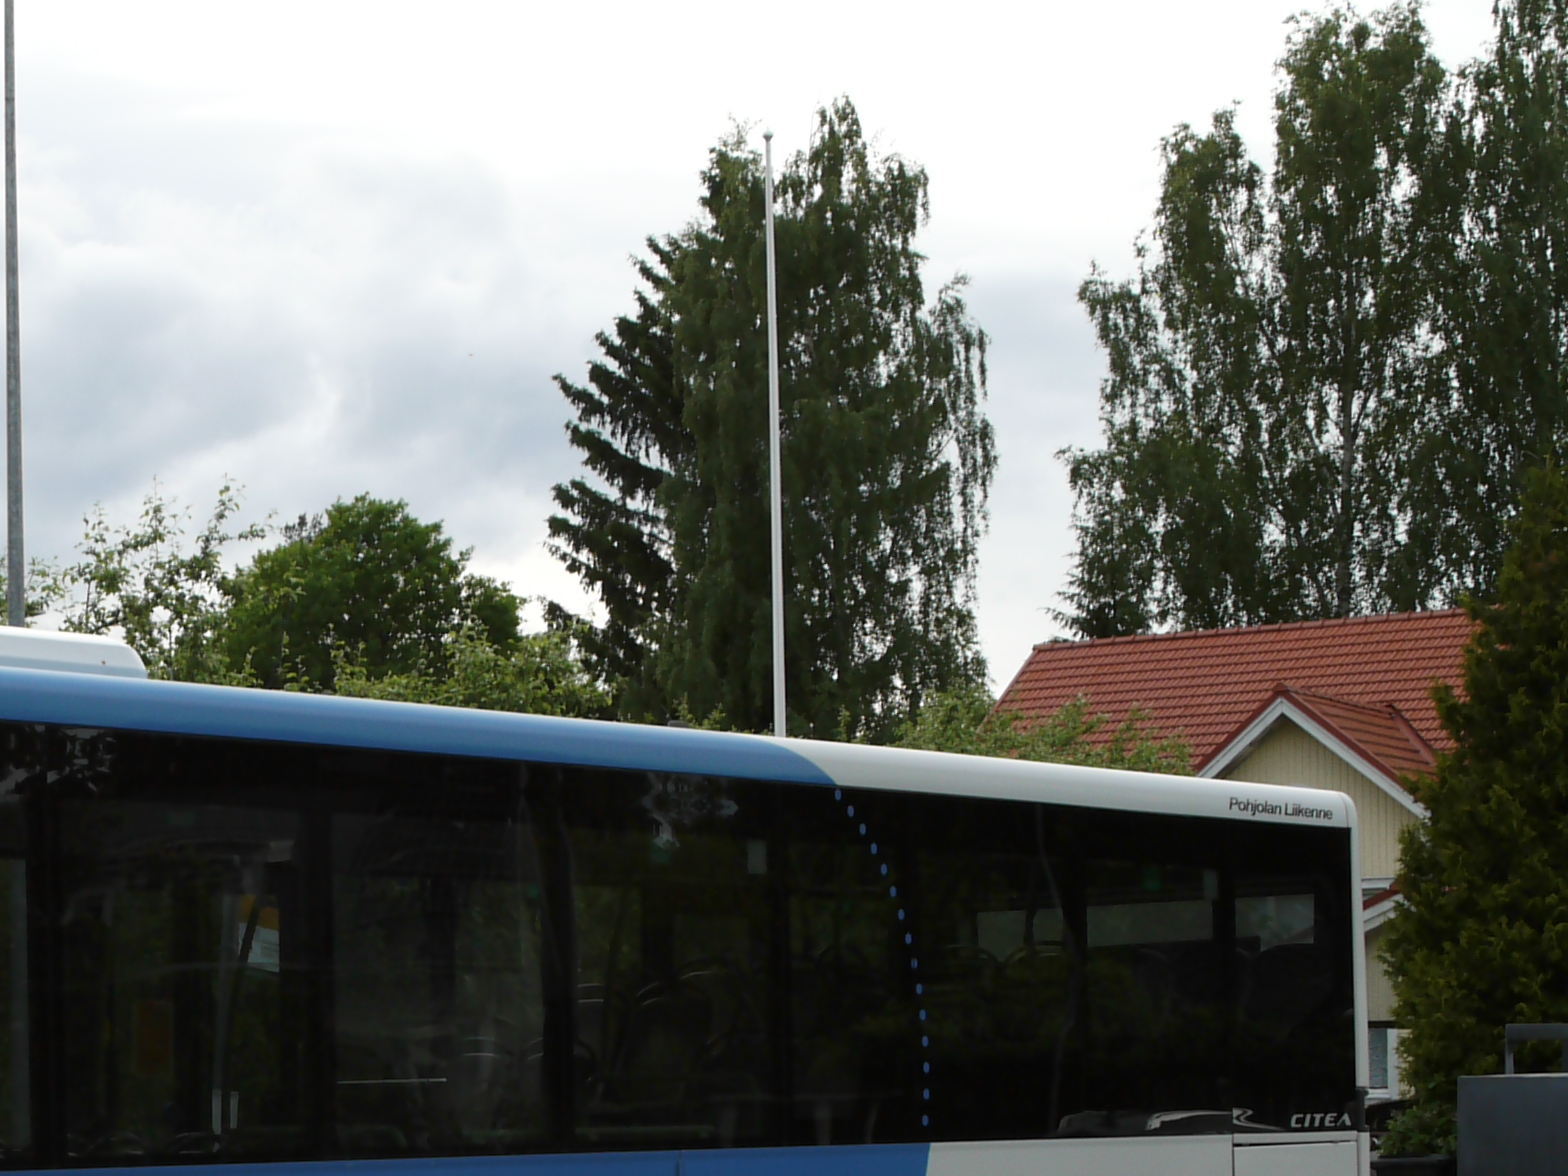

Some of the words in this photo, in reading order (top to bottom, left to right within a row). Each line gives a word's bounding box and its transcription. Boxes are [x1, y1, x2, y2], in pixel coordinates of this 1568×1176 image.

[1229, 797, 1282, 816] Pohjolan
[1284, 803, 1334, 820] Liikenne
[1290, 1112, 1352, 1128] CITEA
